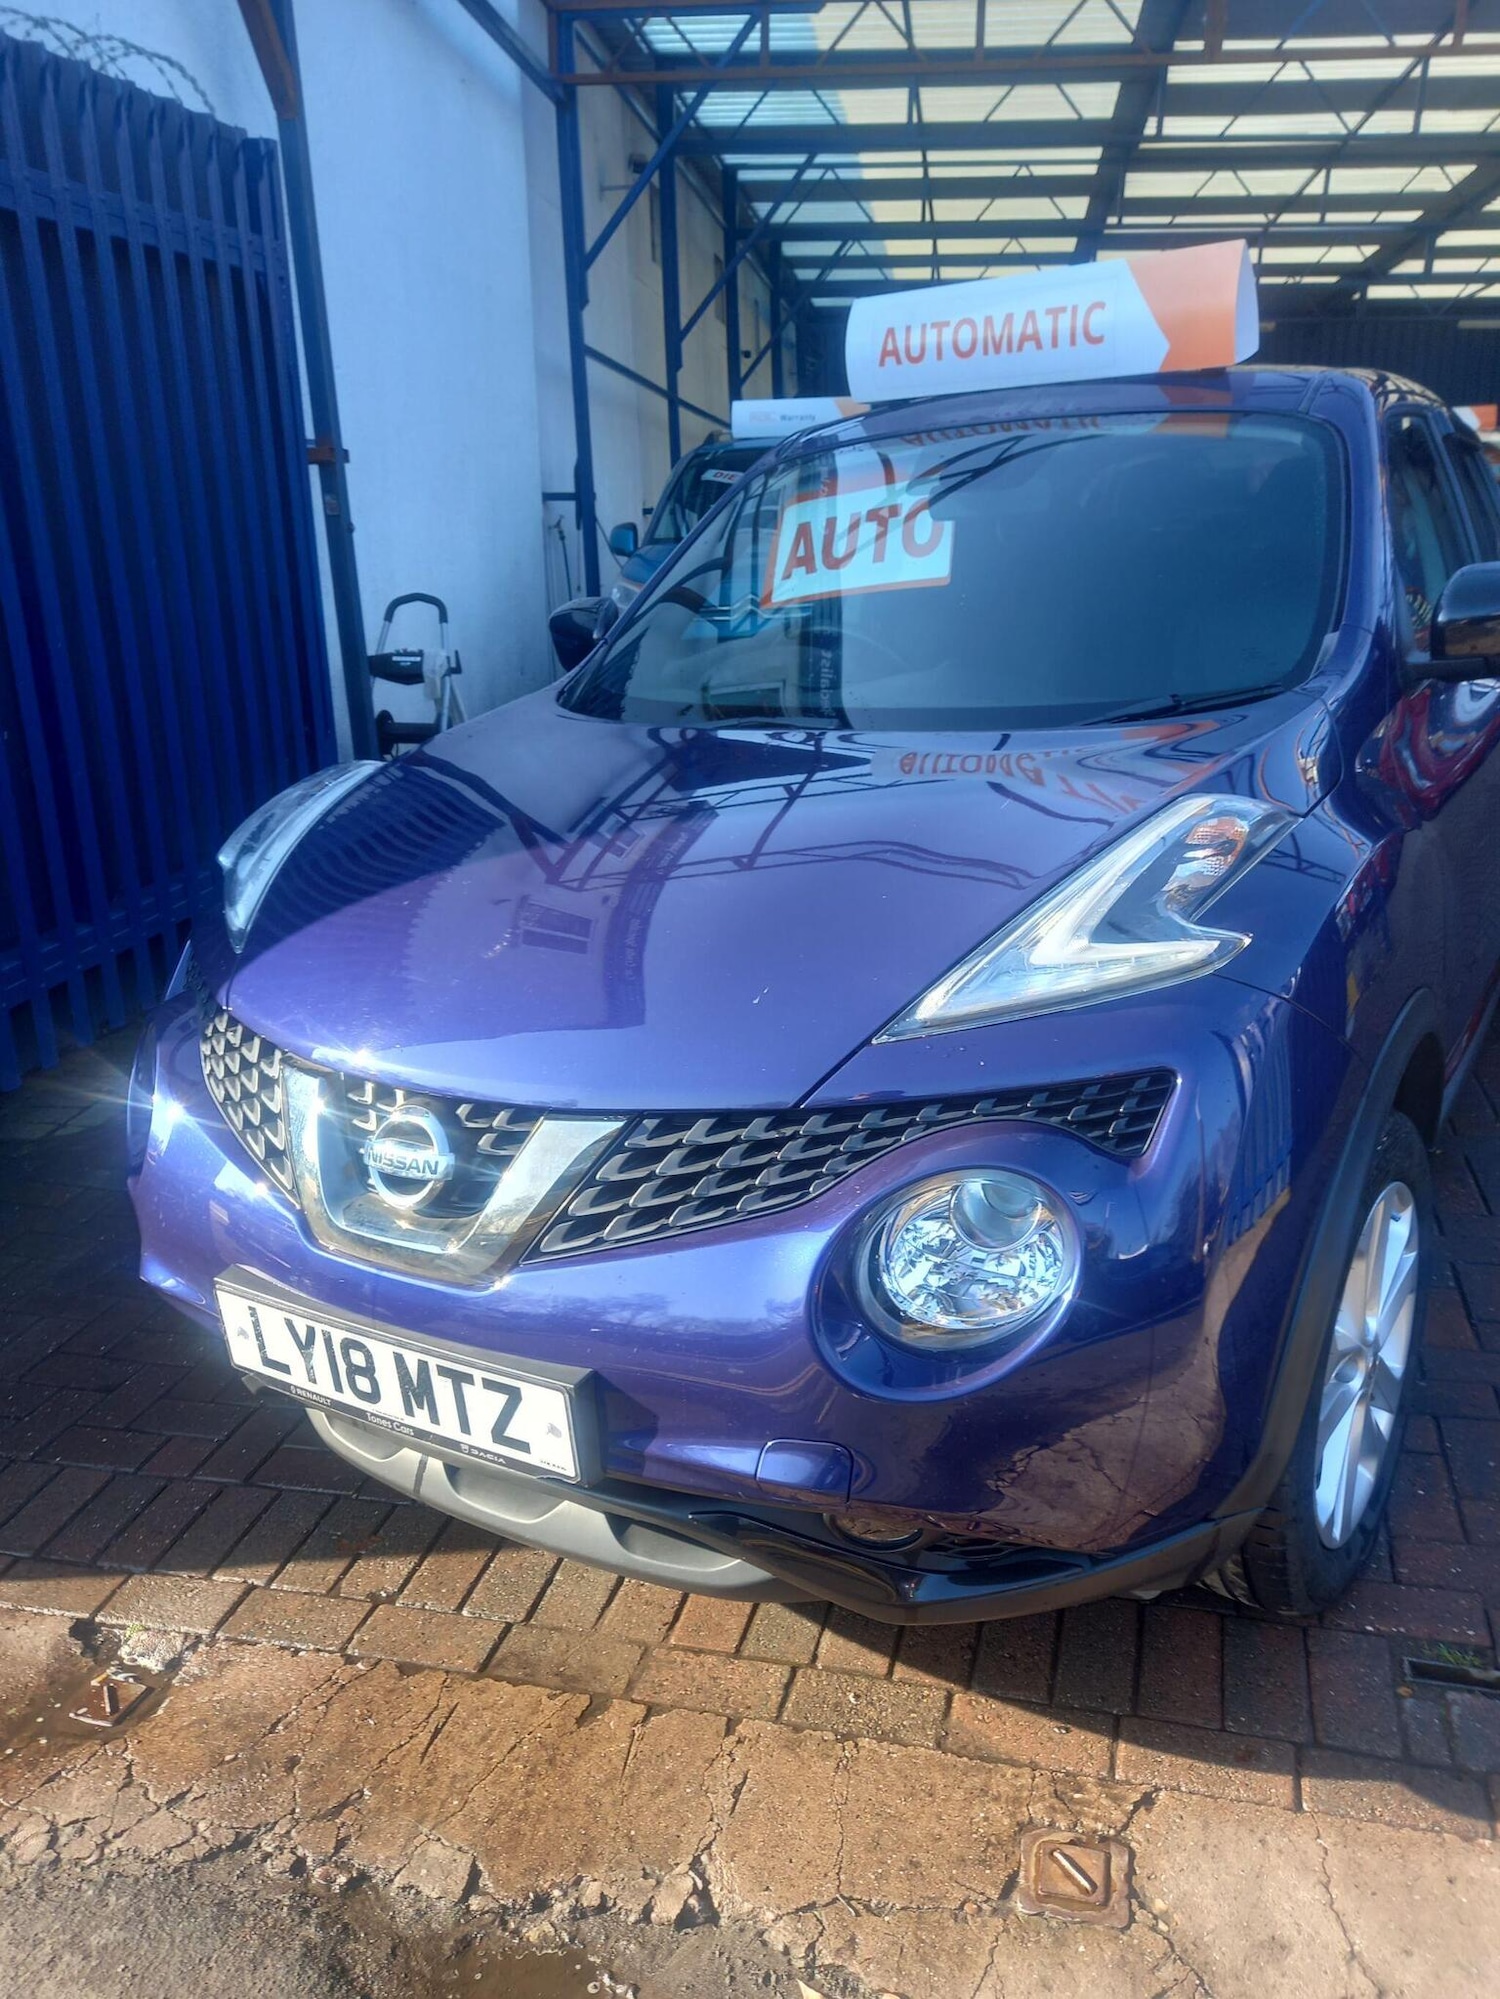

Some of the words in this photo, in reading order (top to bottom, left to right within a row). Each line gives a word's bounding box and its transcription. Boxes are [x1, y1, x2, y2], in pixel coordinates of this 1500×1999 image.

[878, 300, 1106, 368] AUTOMATIC
[781, 498, 944, 580] AUTO
[367, 1149, 439, 1176] NISSAN
[248, 1306, 382, 1405] LY18
[393, 1351, 531, 1454] MTZ
[296, 1387, 331, 1406] RENAULT
[366, 1412, 392, 1428] Tones
[393, 1422, 415, 1437] Cars
[470, 1449, 507, 1464] DACIA
